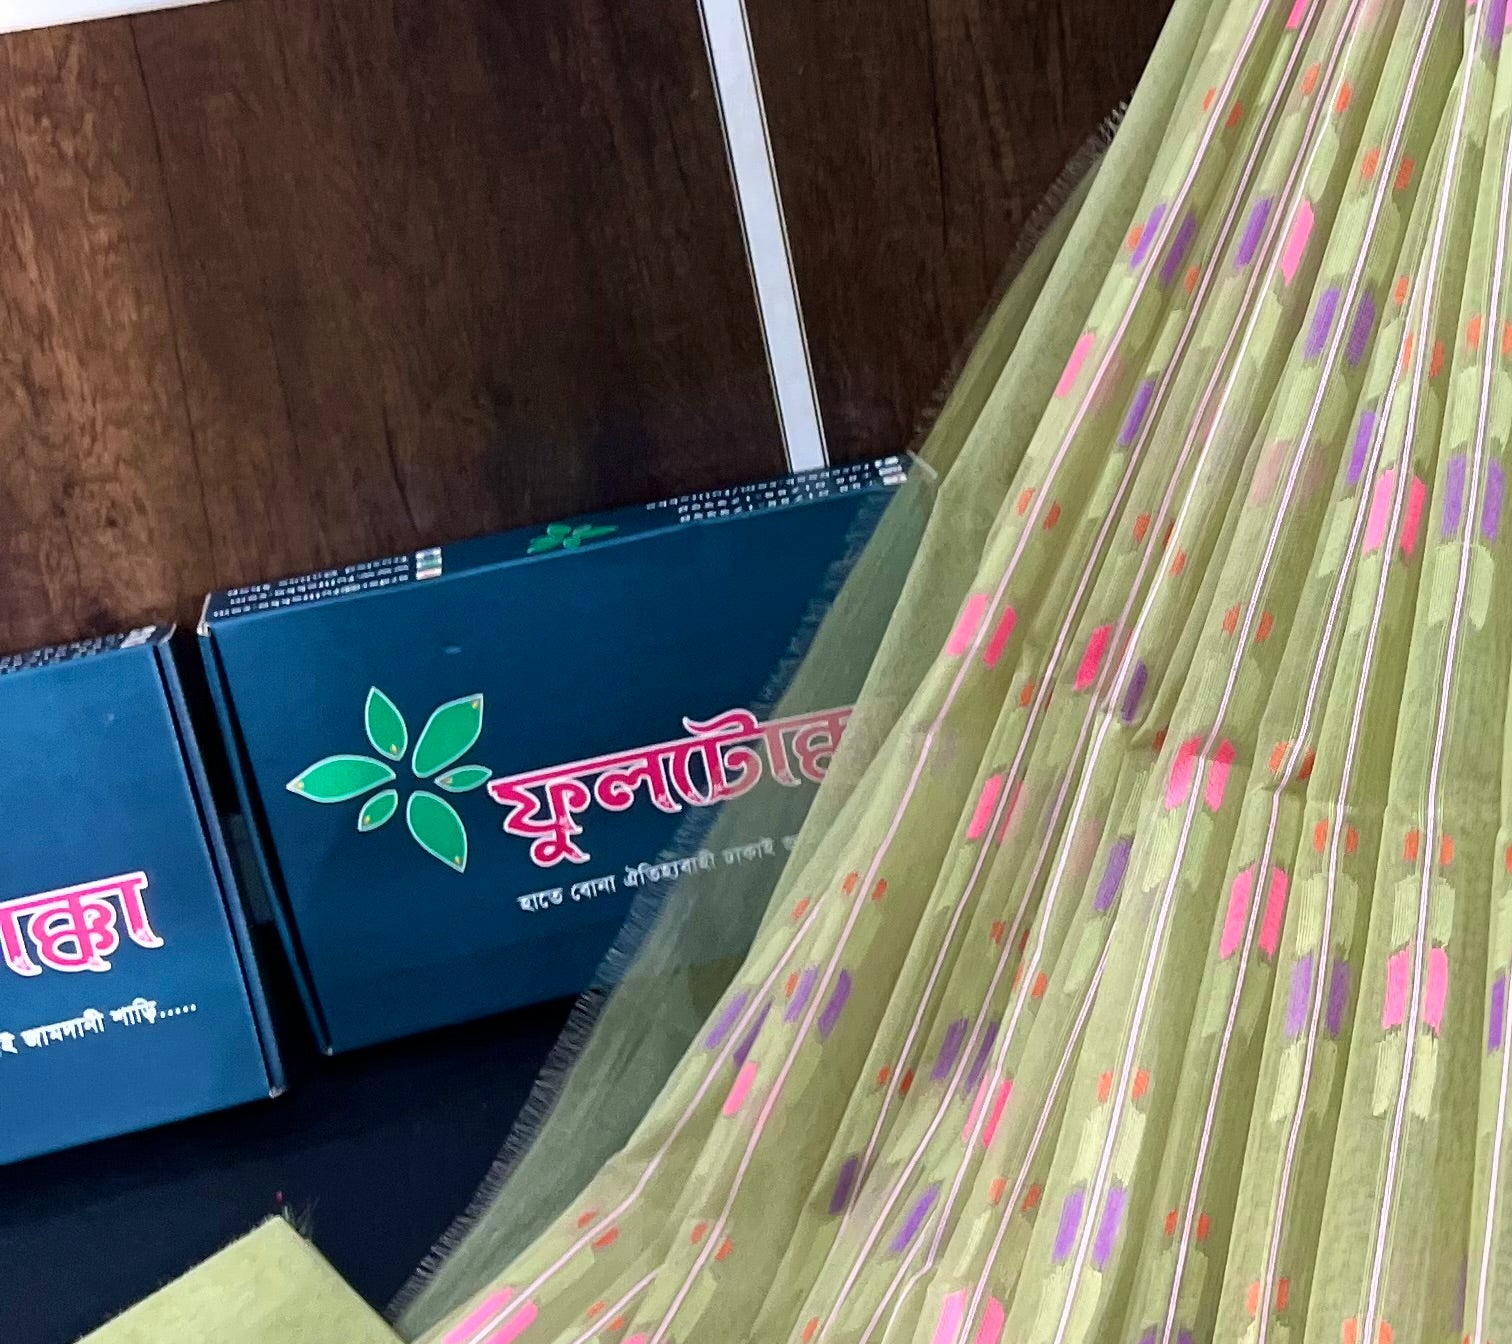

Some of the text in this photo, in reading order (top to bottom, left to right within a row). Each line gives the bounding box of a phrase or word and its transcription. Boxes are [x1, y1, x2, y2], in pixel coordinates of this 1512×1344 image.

[516, 887, 563, 913] হাতে
[571, 874, 616, 901] বোনা
[20, 1008, 105, 1048] জামদানী
